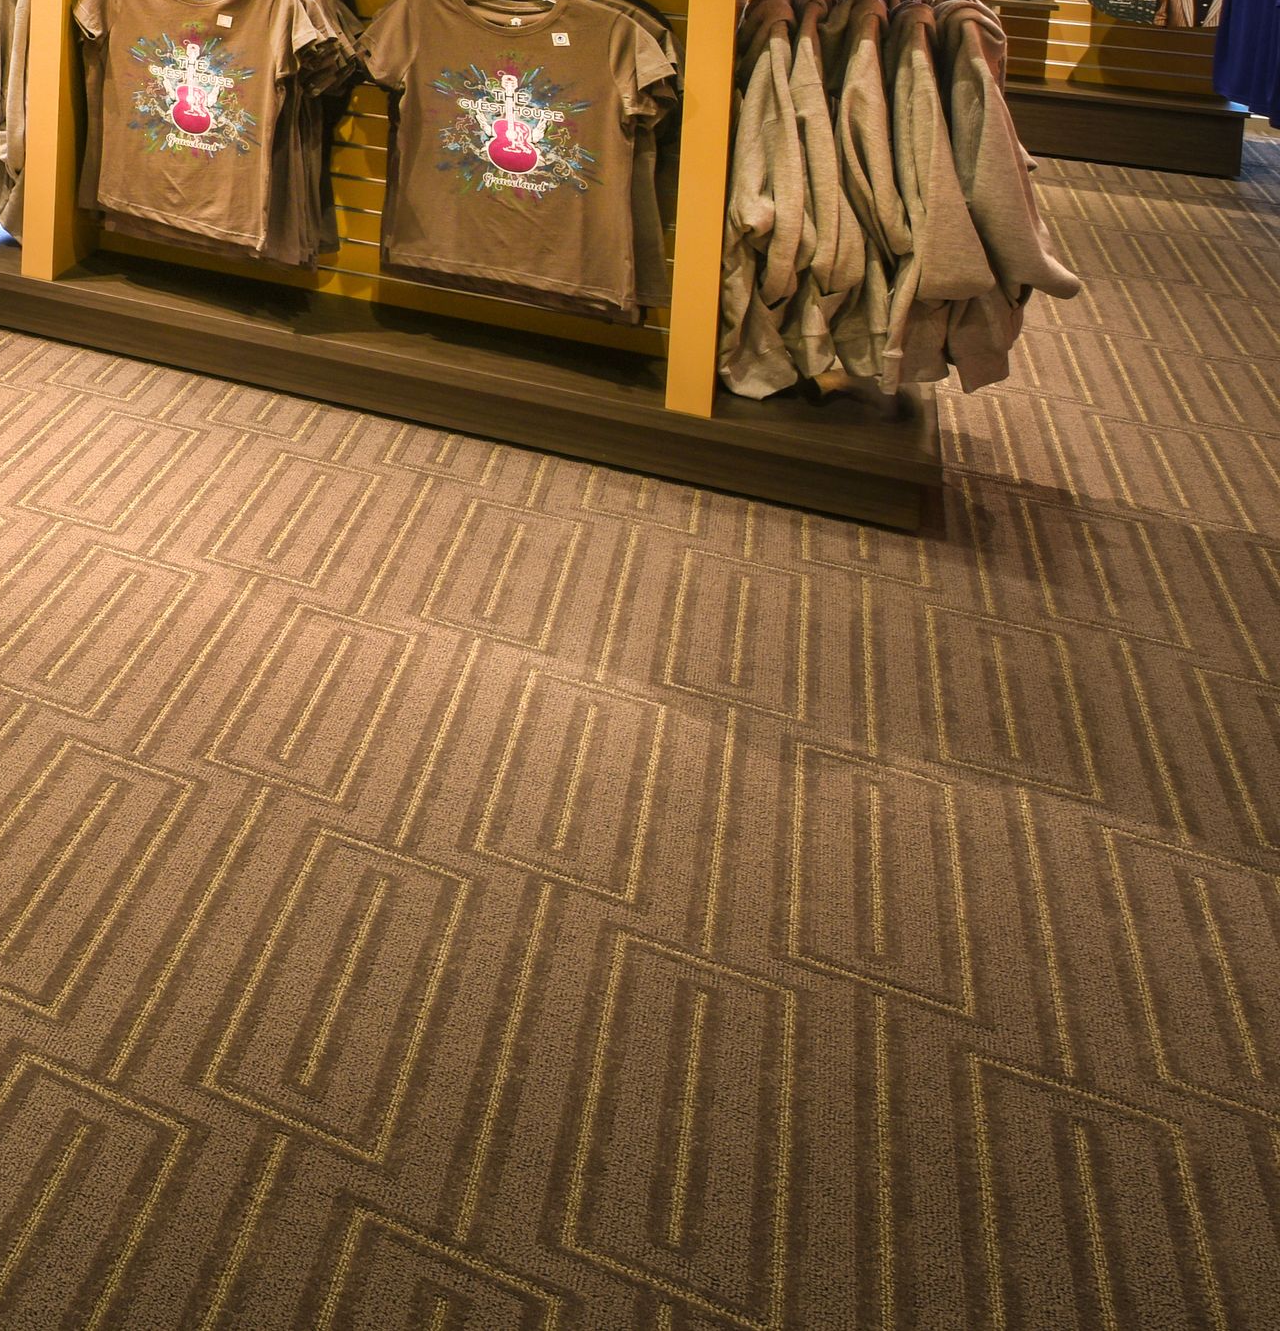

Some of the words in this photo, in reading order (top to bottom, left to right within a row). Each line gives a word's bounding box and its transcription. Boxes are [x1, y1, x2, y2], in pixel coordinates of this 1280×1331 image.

[179, 57, 209, 71] THE
[150, 66, 187, 80] GUEST
[193, 72, 234, 88] HOUSE
[493, 89, 530, 106] THE
[458, 98, 507, 114] GUEST
[513, 105, 564, 122] HOUSE
